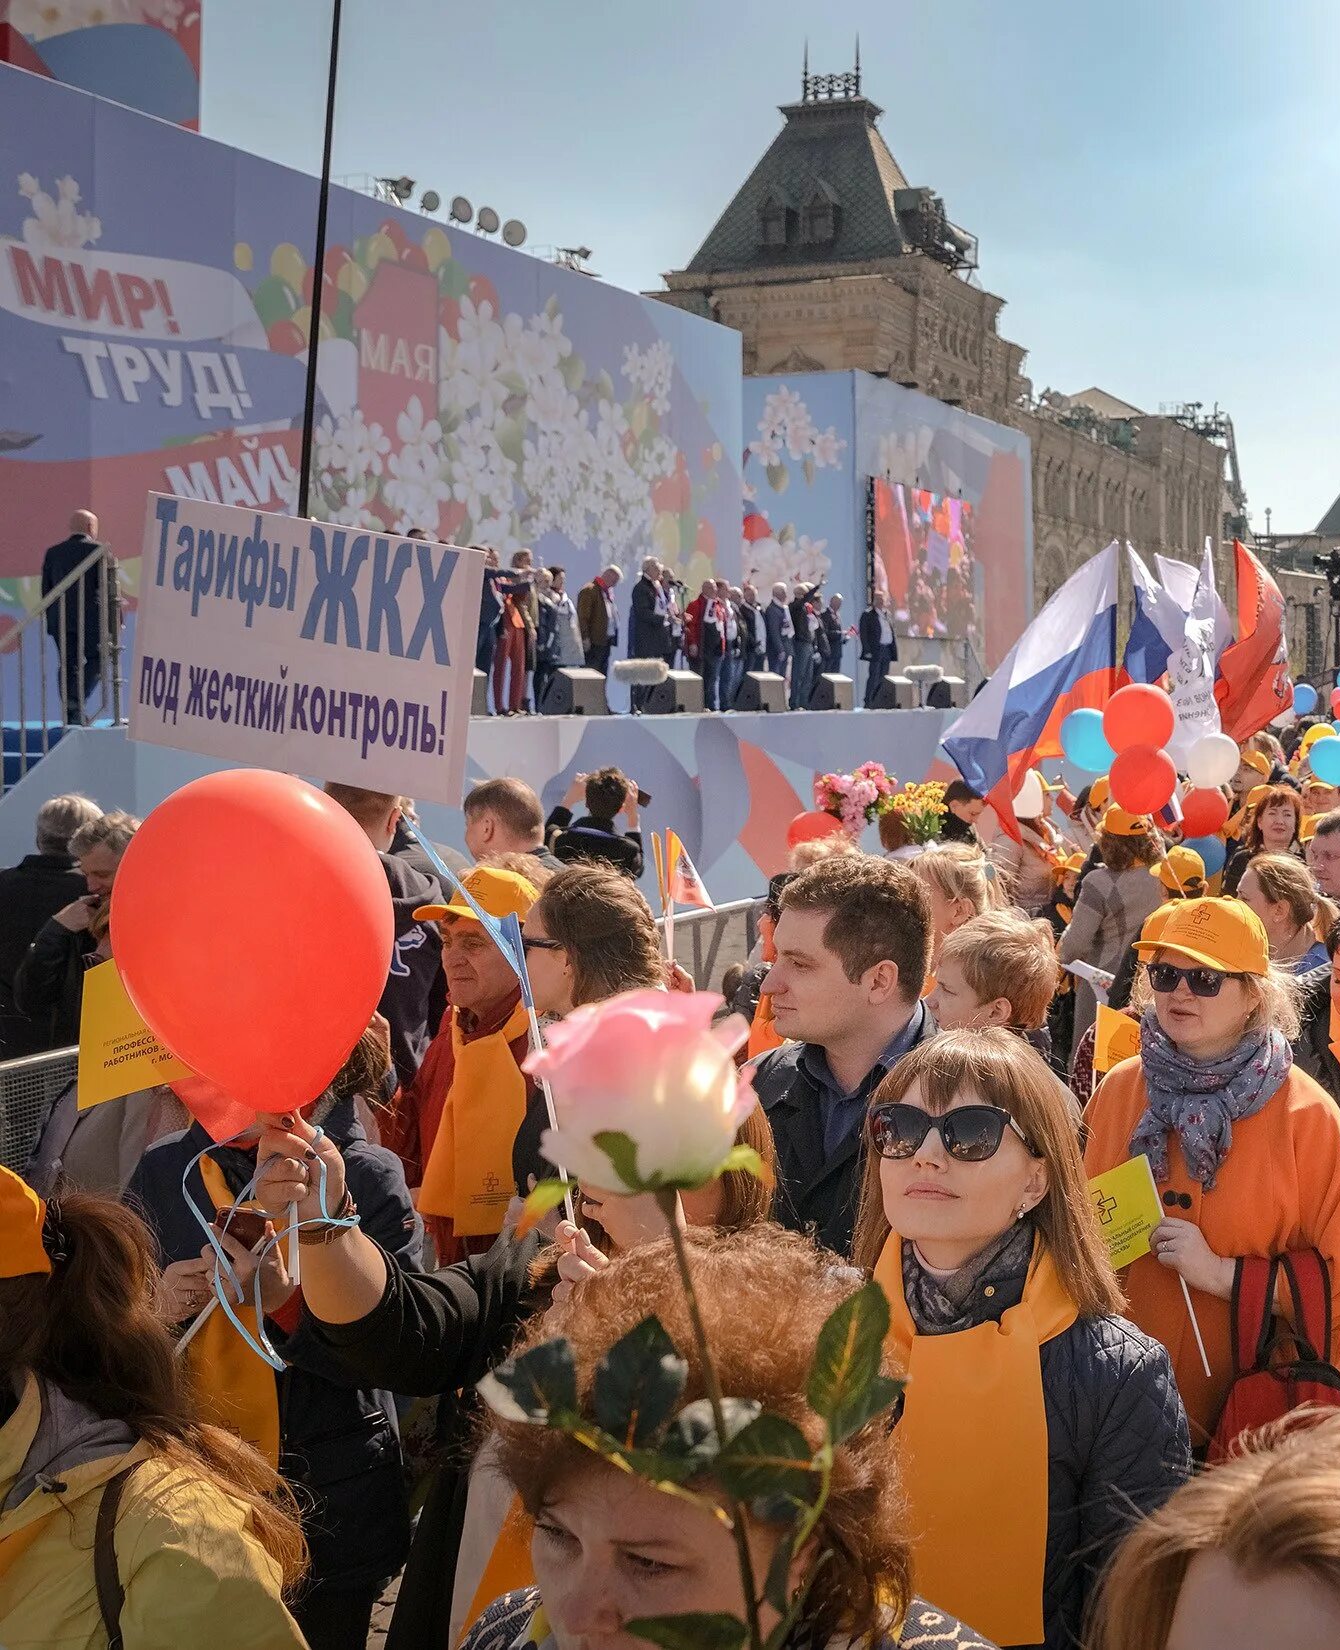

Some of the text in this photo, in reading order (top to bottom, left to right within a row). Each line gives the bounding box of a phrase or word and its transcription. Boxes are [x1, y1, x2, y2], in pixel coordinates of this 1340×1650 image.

[9, 246, 180, 334] МИР!
[60, 336, 253, 419] ТРУД!
[360, 328, 437, 384] МАЯ
[165, 439, 298, 507] МАЙ!
[156, 498, 460, 667] Тарифы ЖКХ
[139, 656, 448, 760] под жесткий контроль!
[103, 1044, 159, 1069] РАБОТНИКОВ
